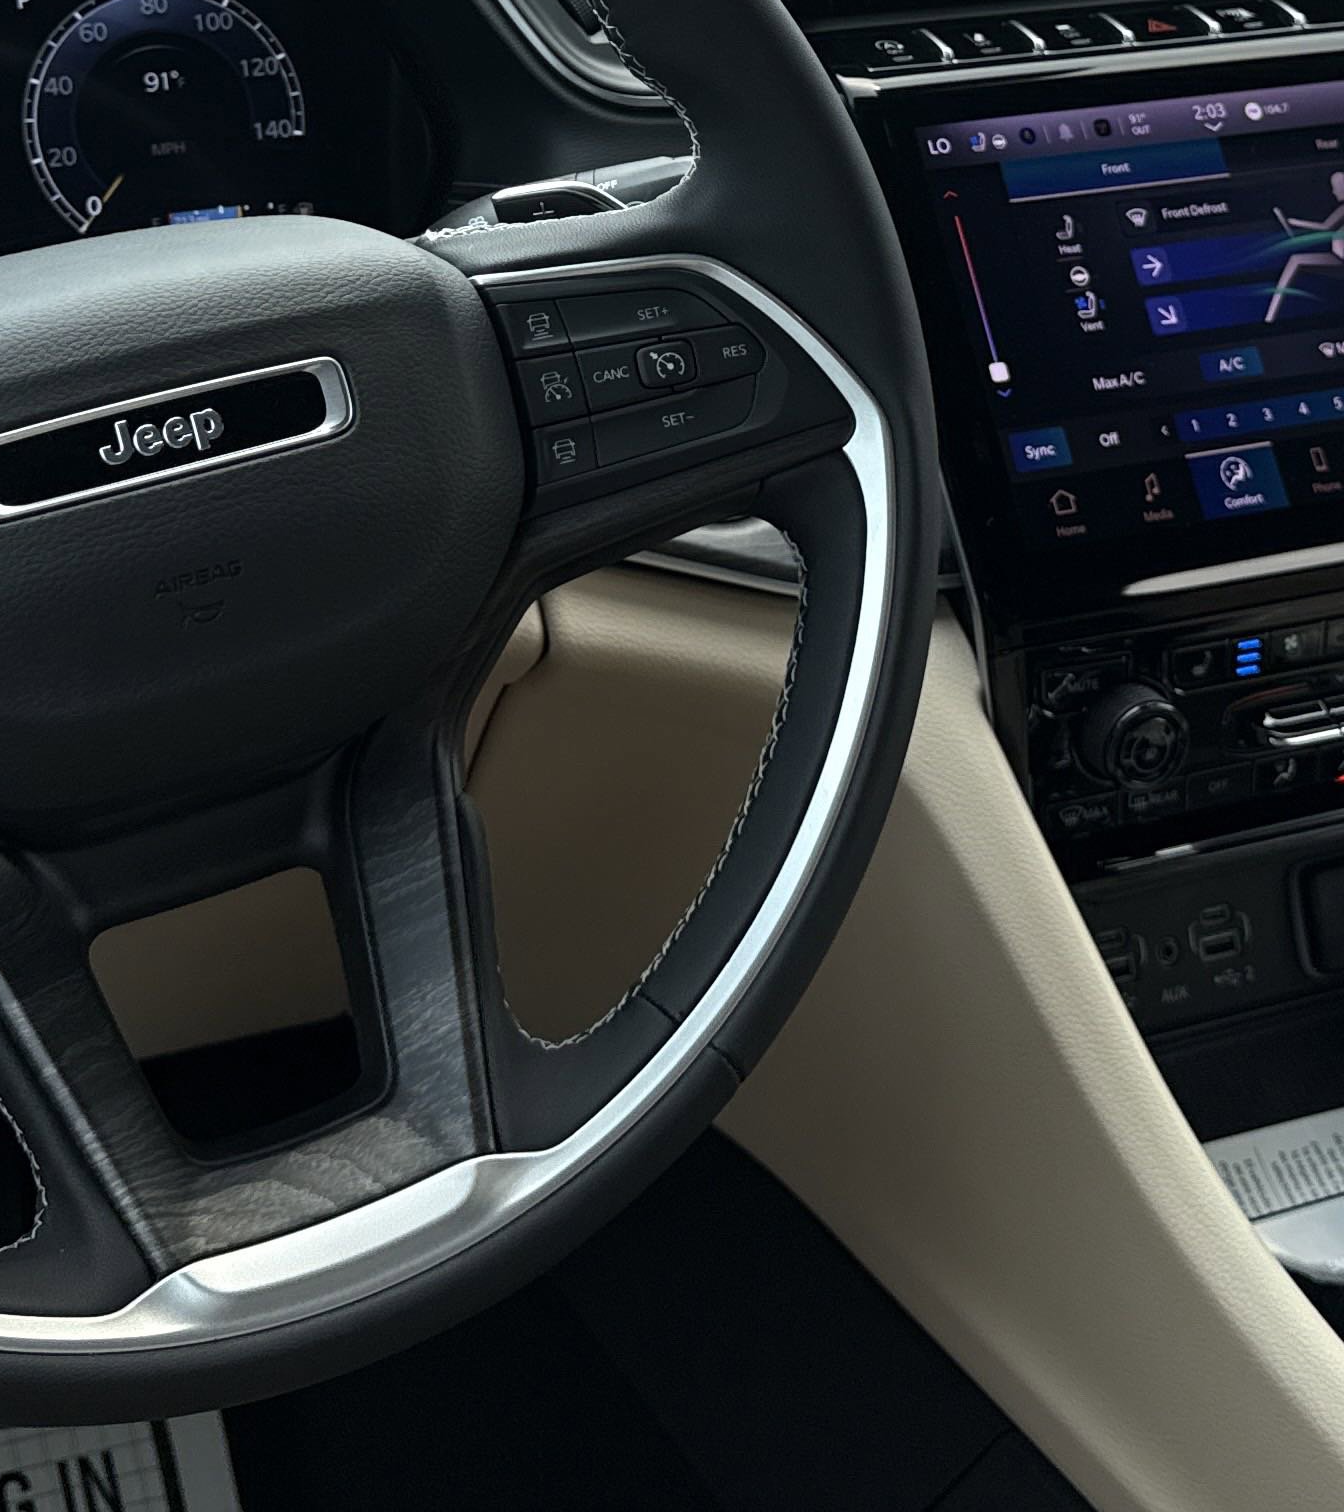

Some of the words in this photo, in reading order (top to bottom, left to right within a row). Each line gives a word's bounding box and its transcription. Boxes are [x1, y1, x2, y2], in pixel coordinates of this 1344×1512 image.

[195, 12, 234, 32] 100
[78, 22, 108, 44] 60
[239, 55, 279, 77] 120
[43, 75, 74, 96] 40
[1192, 103, 1227, 120] 2:03
[253, 119, 292, 140] 140
[47, 145, 77, 167] 20
[151, 140, 187, 156] MPH
[928, 137, 953, 156] LO
[1100, 160, 1131, 176] Front
[85, 195, 103, 216] 0
[1160, 206, 1190, 220] Front
[1190, 202, 1229, 218] Defrost
[1058, 242, 1082, 256] Heat
[636, 306, 670, 321] SET+
[1080, 320, 1104, 333] Vent
[722, 343, 748, 360] RES
[1218, 356, 1245, 373] A/C
[592, 365, 631, 385] CANC
[1093, 374, 1119, 391] Max
[1119, 370, 1147, 388] A/C
[1191, 418, 1201, 433] 1
[1226, 413, 1239, 428] 2
[1262, 407, 1275, 423] 3
[1298, 401, 1311, 416] 4
[98, 407, 225, 466] Jeep
[1099, 431, 1121, 448] Off
[1024, 443, 1056, 462] Sync
[1224, 493, 1265, 510] Comfort
[1143, 509, 1174, 523] Media
[1056, 523, 1087, 537] Home
[153, 558, 243, 600] AIRBAG
[1161, 985, 1192, 1004] AUX
[57, 1449, 127, 1512] IN
